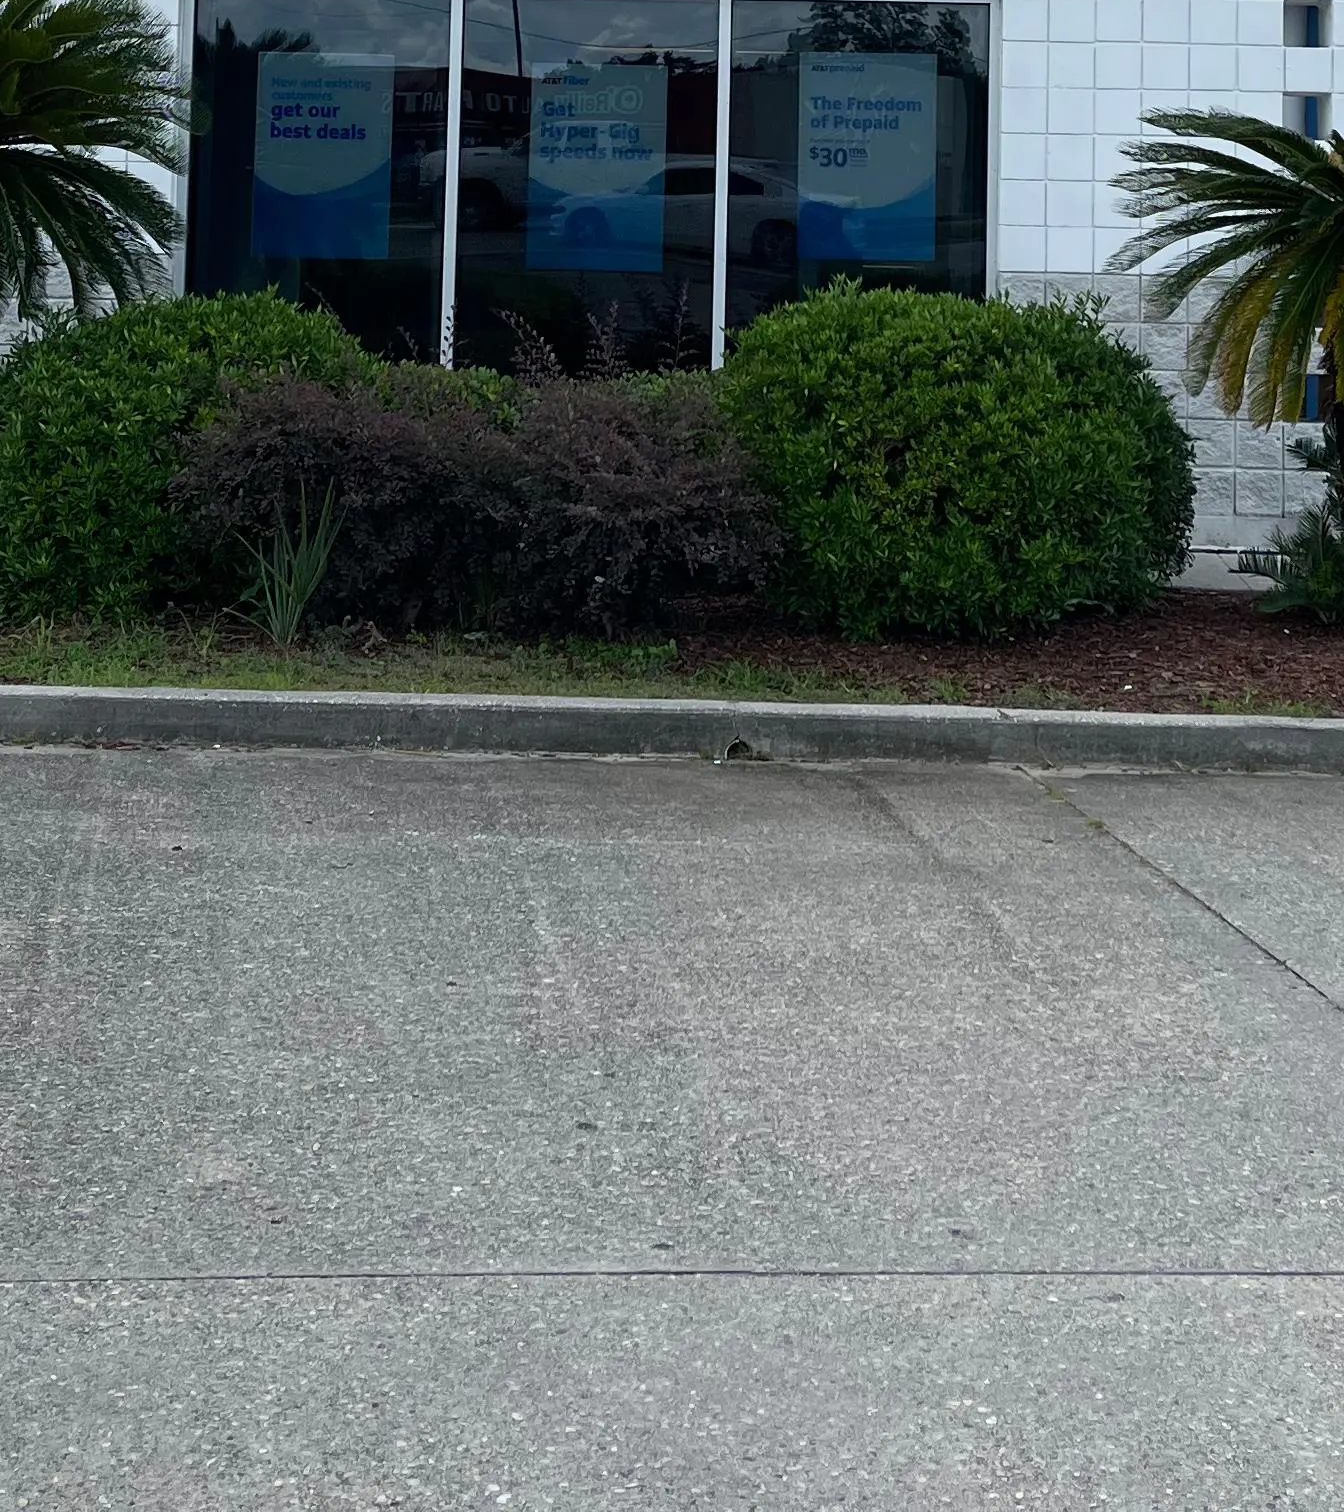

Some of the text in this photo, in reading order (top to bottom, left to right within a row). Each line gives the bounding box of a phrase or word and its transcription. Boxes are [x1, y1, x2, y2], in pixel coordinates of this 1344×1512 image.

[301, 77, 322, 89] and
[323, 78, 371, 91] existing
[271, 91, 333, 101] customers
[810, 96, 922, 112] The Freedom
[271, 103, 340, 121] get our
[543, 101, 575, 117] Get
[270, 121, 366, 140] best deals
[810, 114, 899, 132] of Prepaid
[540, 121, 640, 144] Hyper-Gig
[539, 143, 653, 164] speeds now
[809, 146, 848, 167] $30
